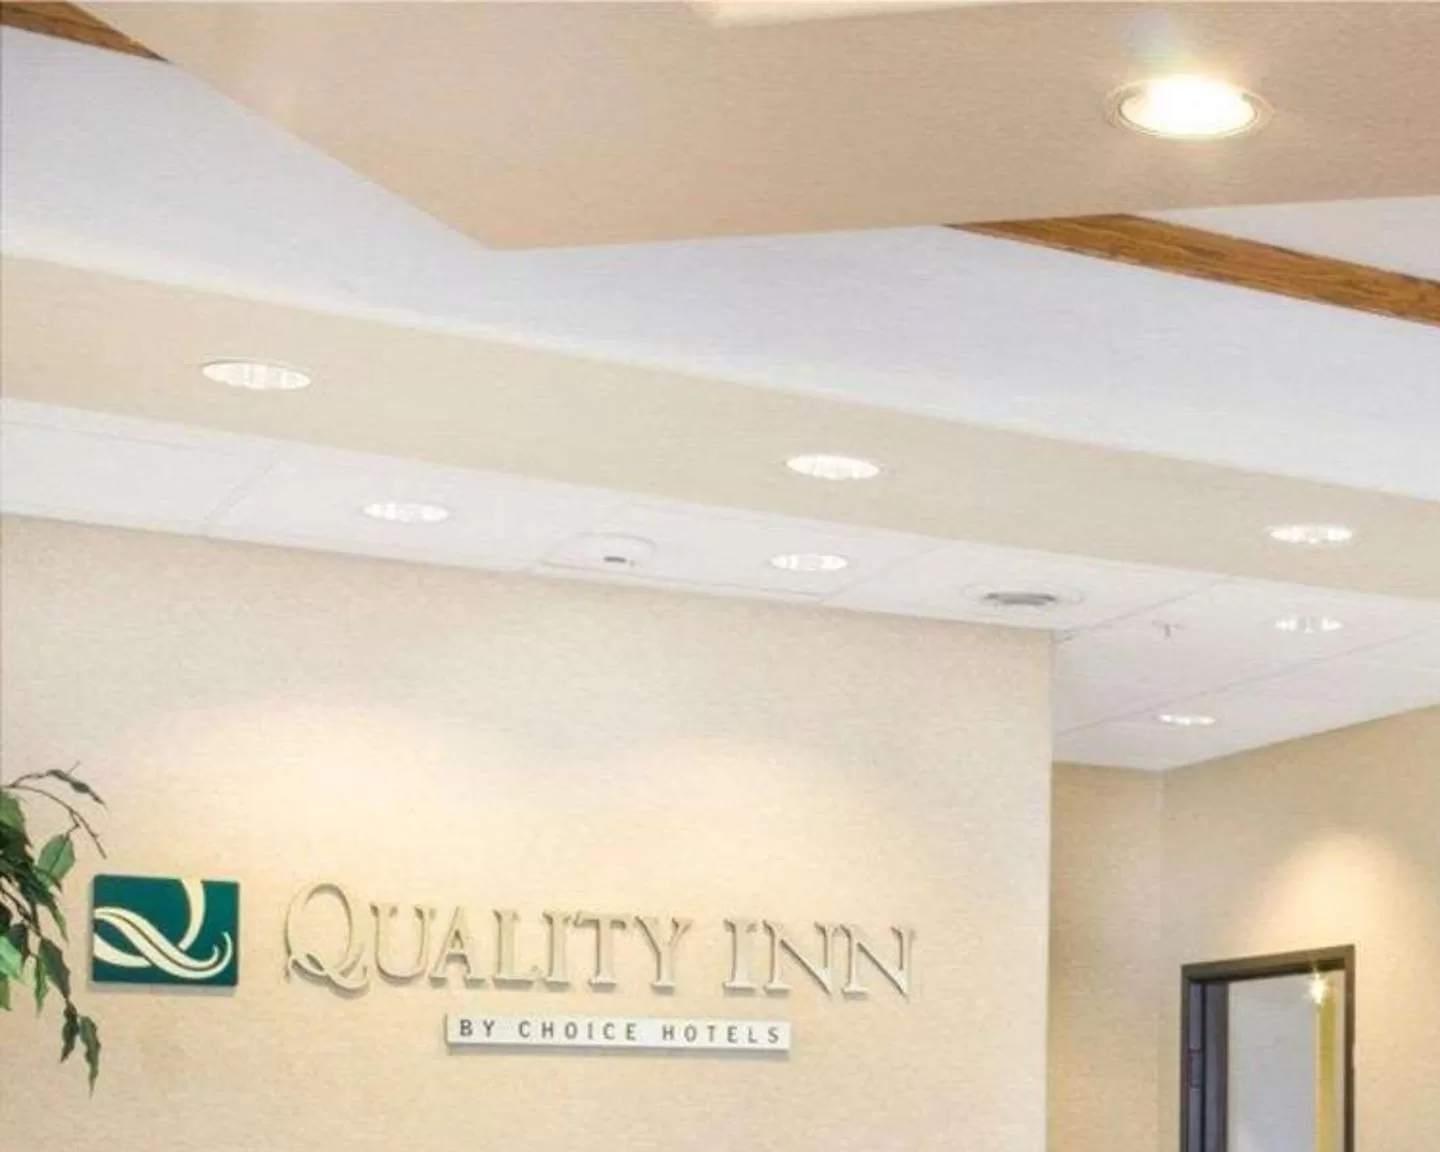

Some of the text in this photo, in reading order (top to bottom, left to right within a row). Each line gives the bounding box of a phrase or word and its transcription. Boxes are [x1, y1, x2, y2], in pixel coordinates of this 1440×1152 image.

[284, 883, 915, 1002] QUALITY INN
[459, 1018, 780, 1045] BY CHOICE HOTELS
